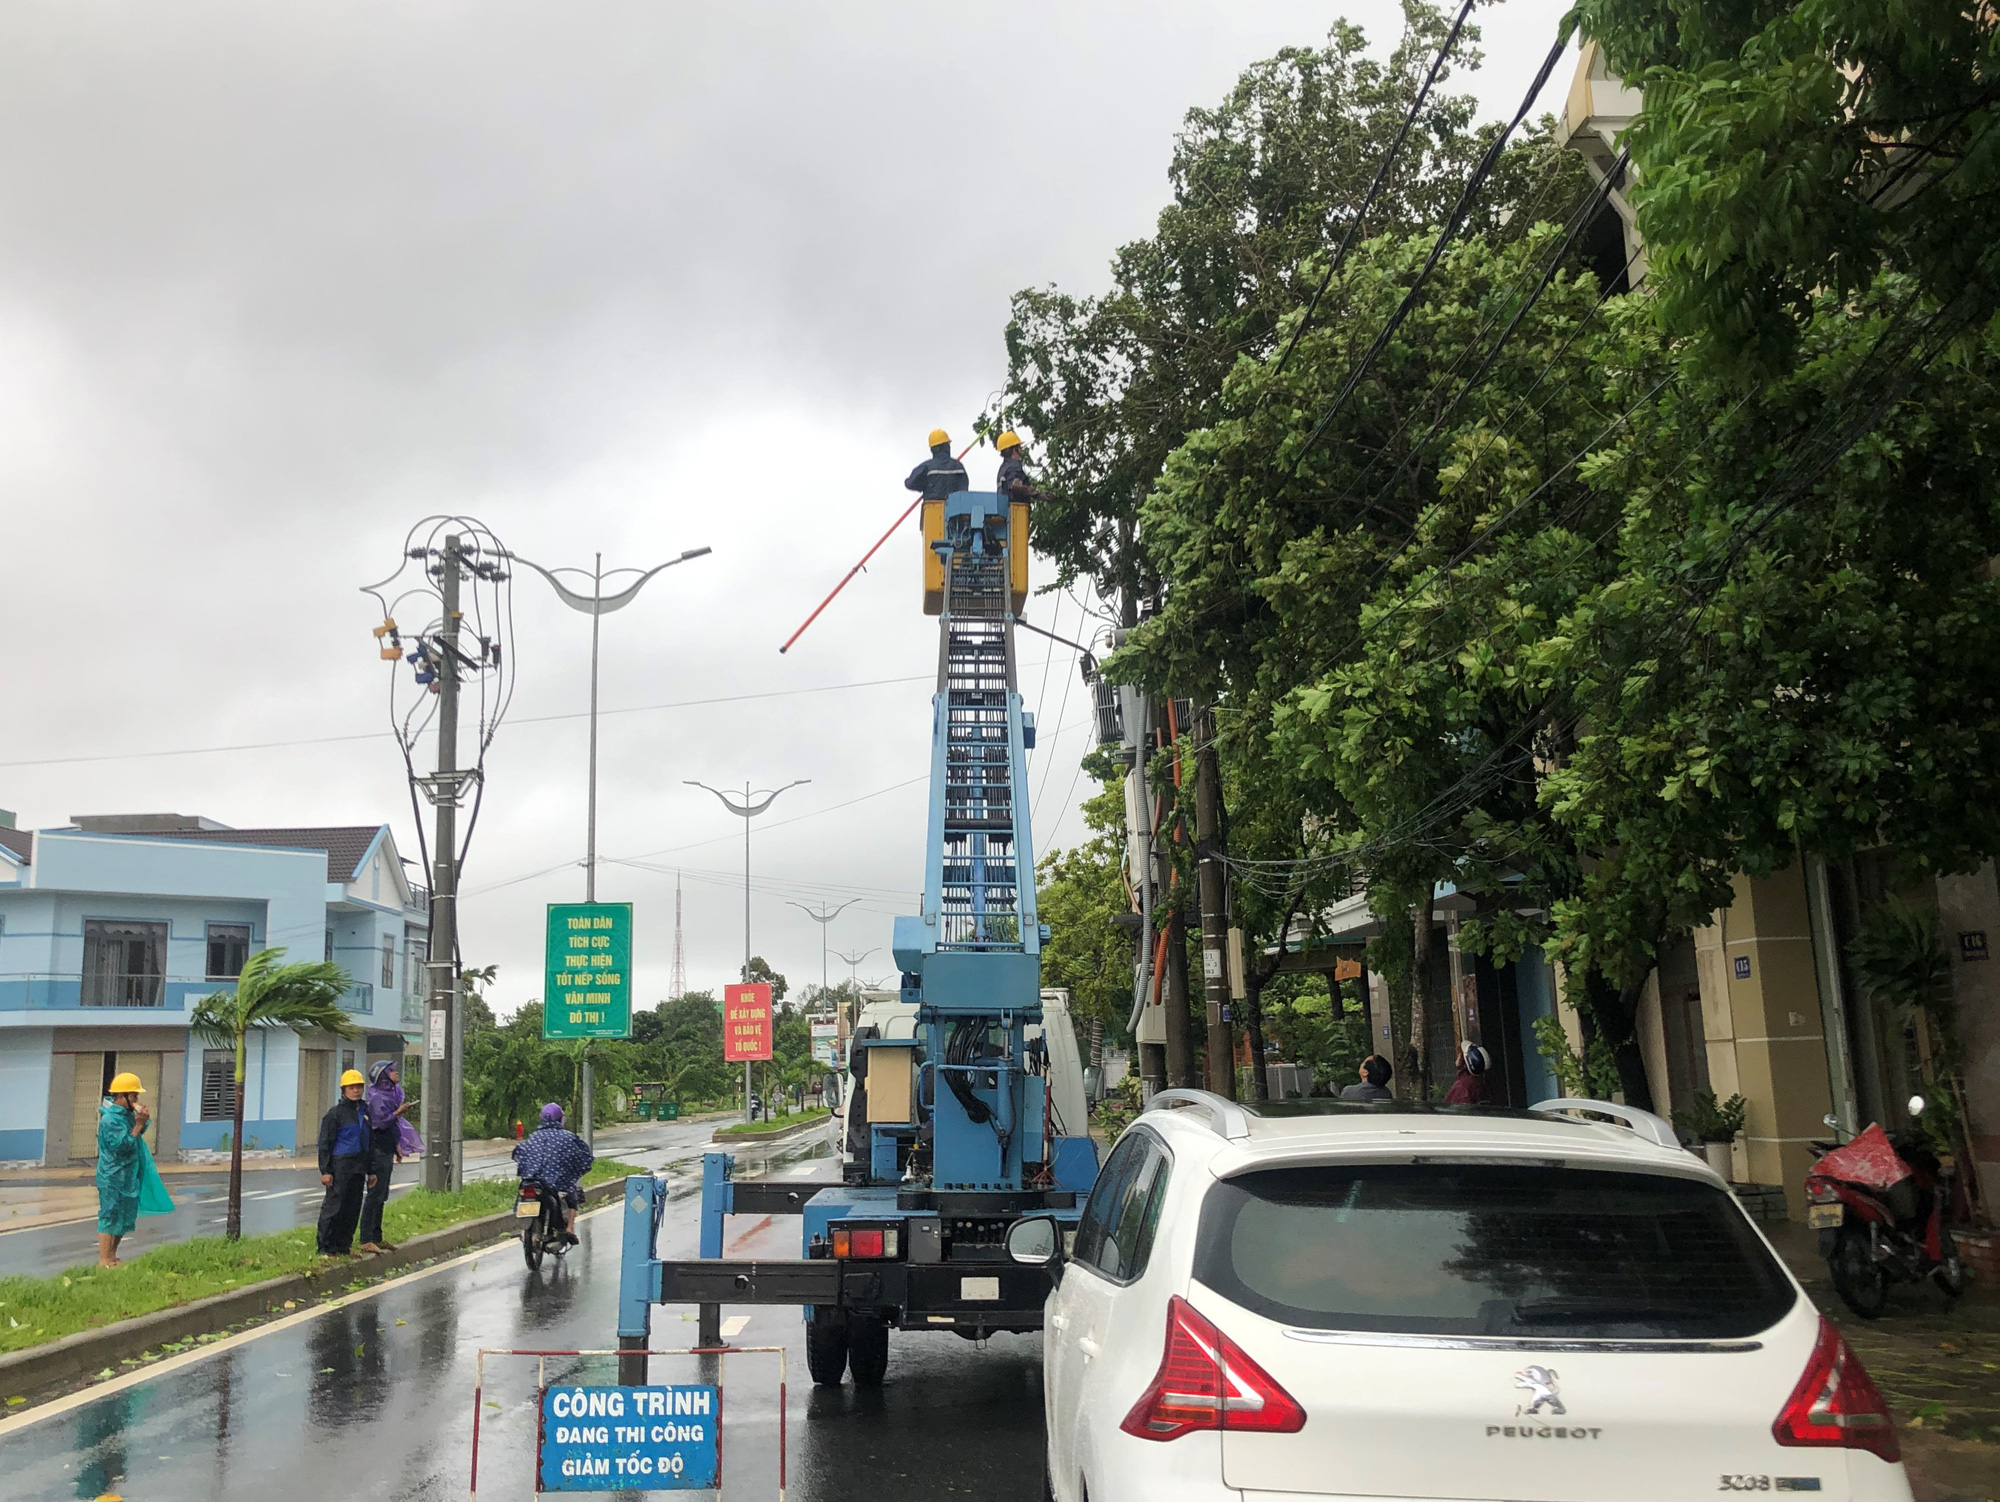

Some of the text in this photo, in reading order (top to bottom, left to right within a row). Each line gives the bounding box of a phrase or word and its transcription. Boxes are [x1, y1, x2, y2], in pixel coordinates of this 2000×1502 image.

[568, 916, 612, 930] TOÀN DÂN
[569, 935, 610, 950] TÍCH CỰC
[566, 954, 612, 968] THỰC HIỆN
[557, 970, 620, 986] TỐT NẾP SỐNG
[566, 991, 610, 1004] VĂN MINH
[570, 1010, 582, 1024] ĐÔ
[585, 1012, 598, 1026] THỊ
[553, 1386, 710, 1418] CÔNG TRÌNH
[556, 1421, 704, 1444] ĐANG THI CÔNG
[1486, 1426, 1603, 1440] PEUGEOT
[561, 1449, 684, 1479] GIẢM TỐC ĐỘ
